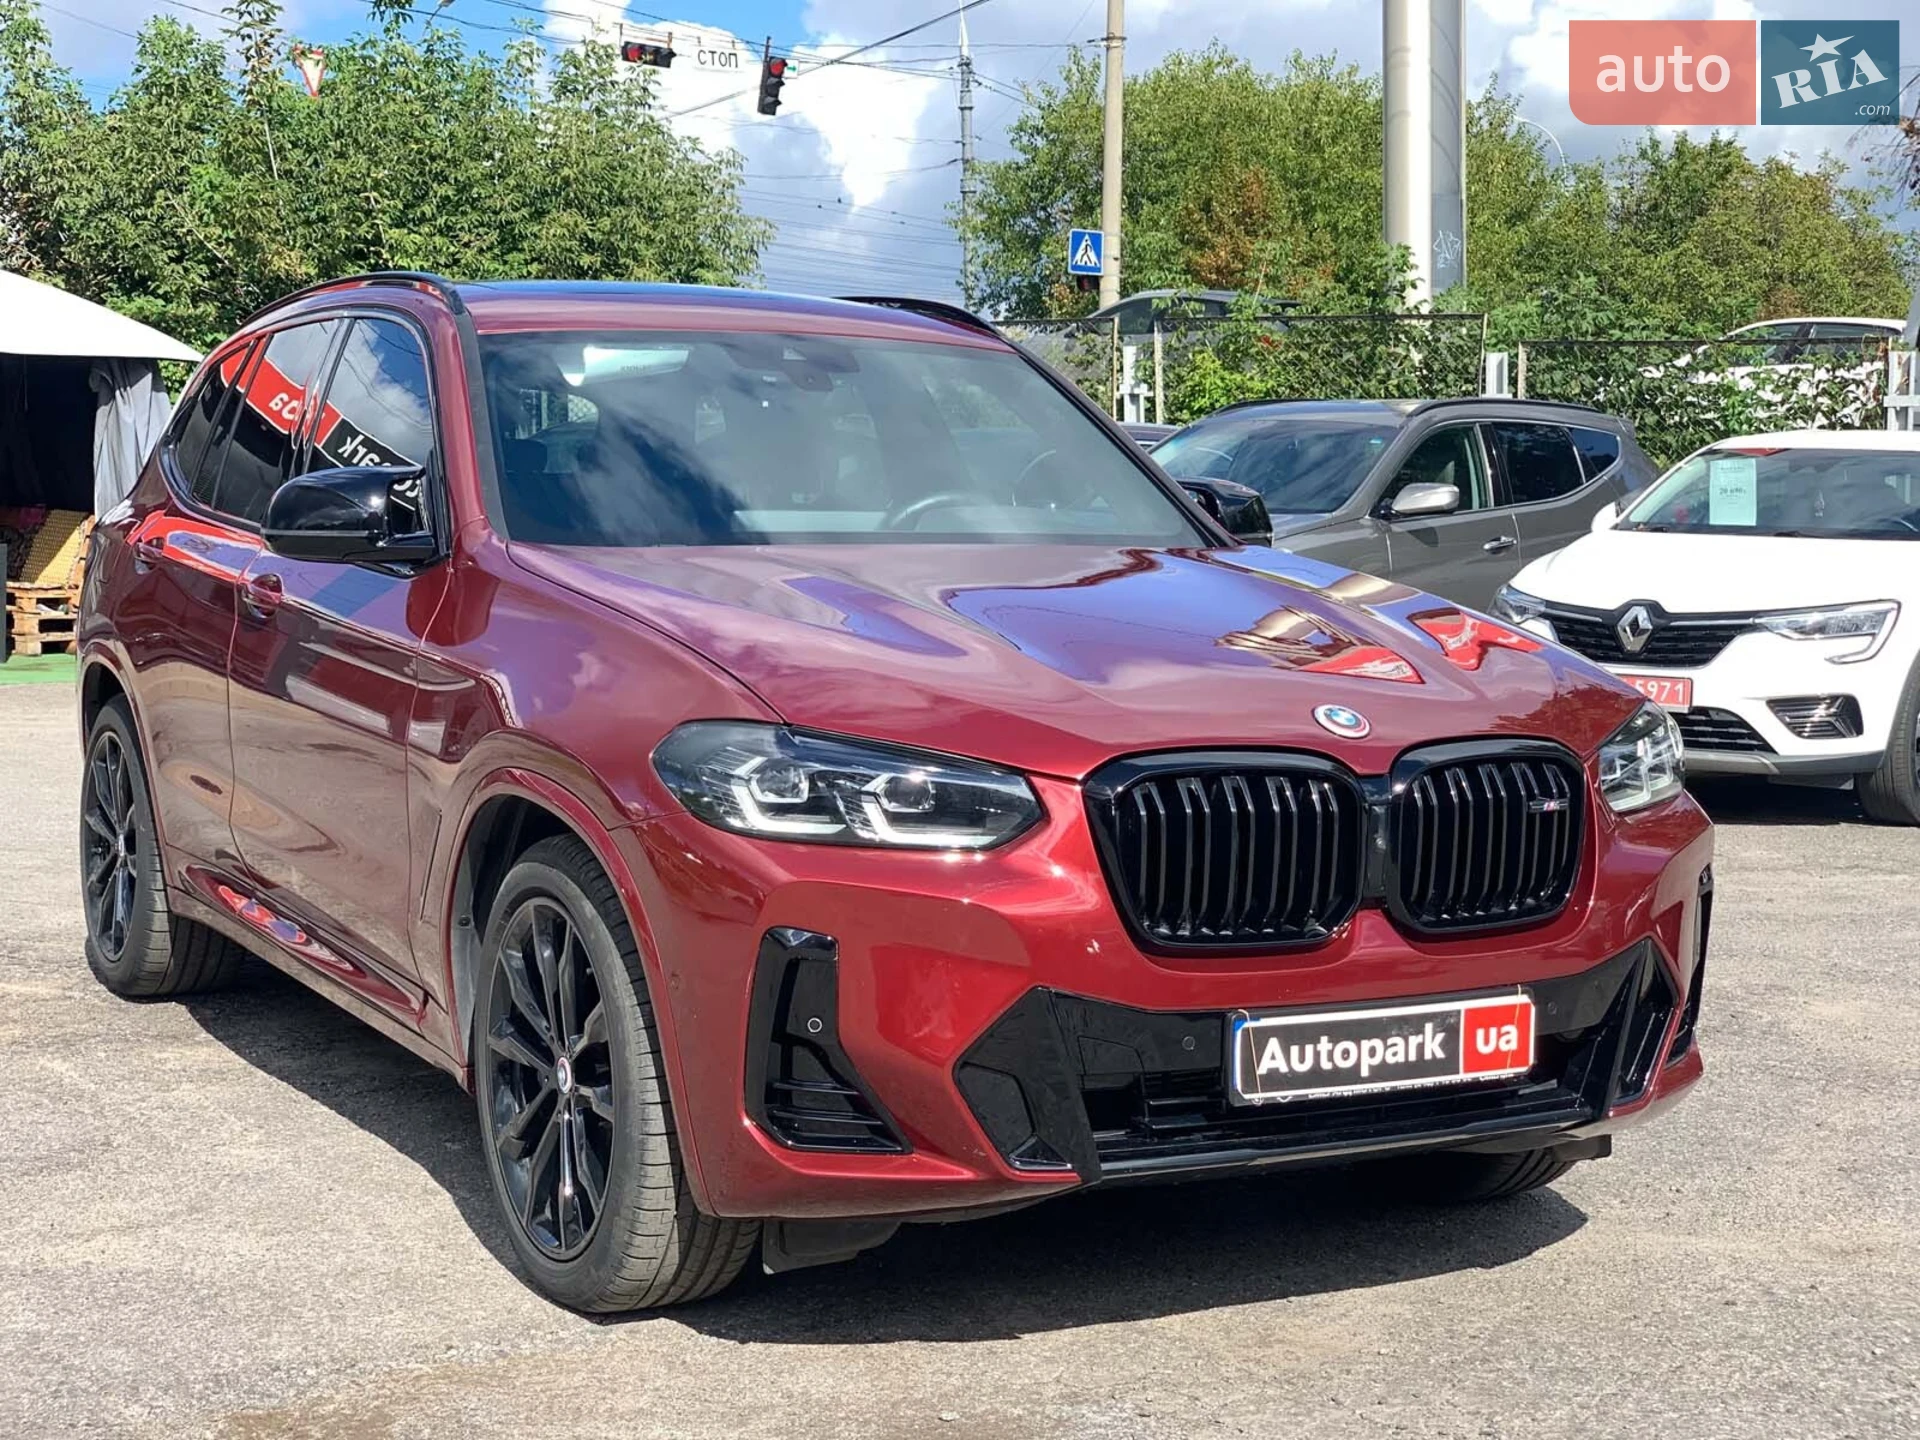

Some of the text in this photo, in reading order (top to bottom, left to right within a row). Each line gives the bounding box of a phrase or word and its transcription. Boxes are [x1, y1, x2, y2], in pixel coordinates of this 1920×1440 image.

[697, 49, 739, 68] СТОП
[1257, 1022, 1519, 1077] Autopark ua
